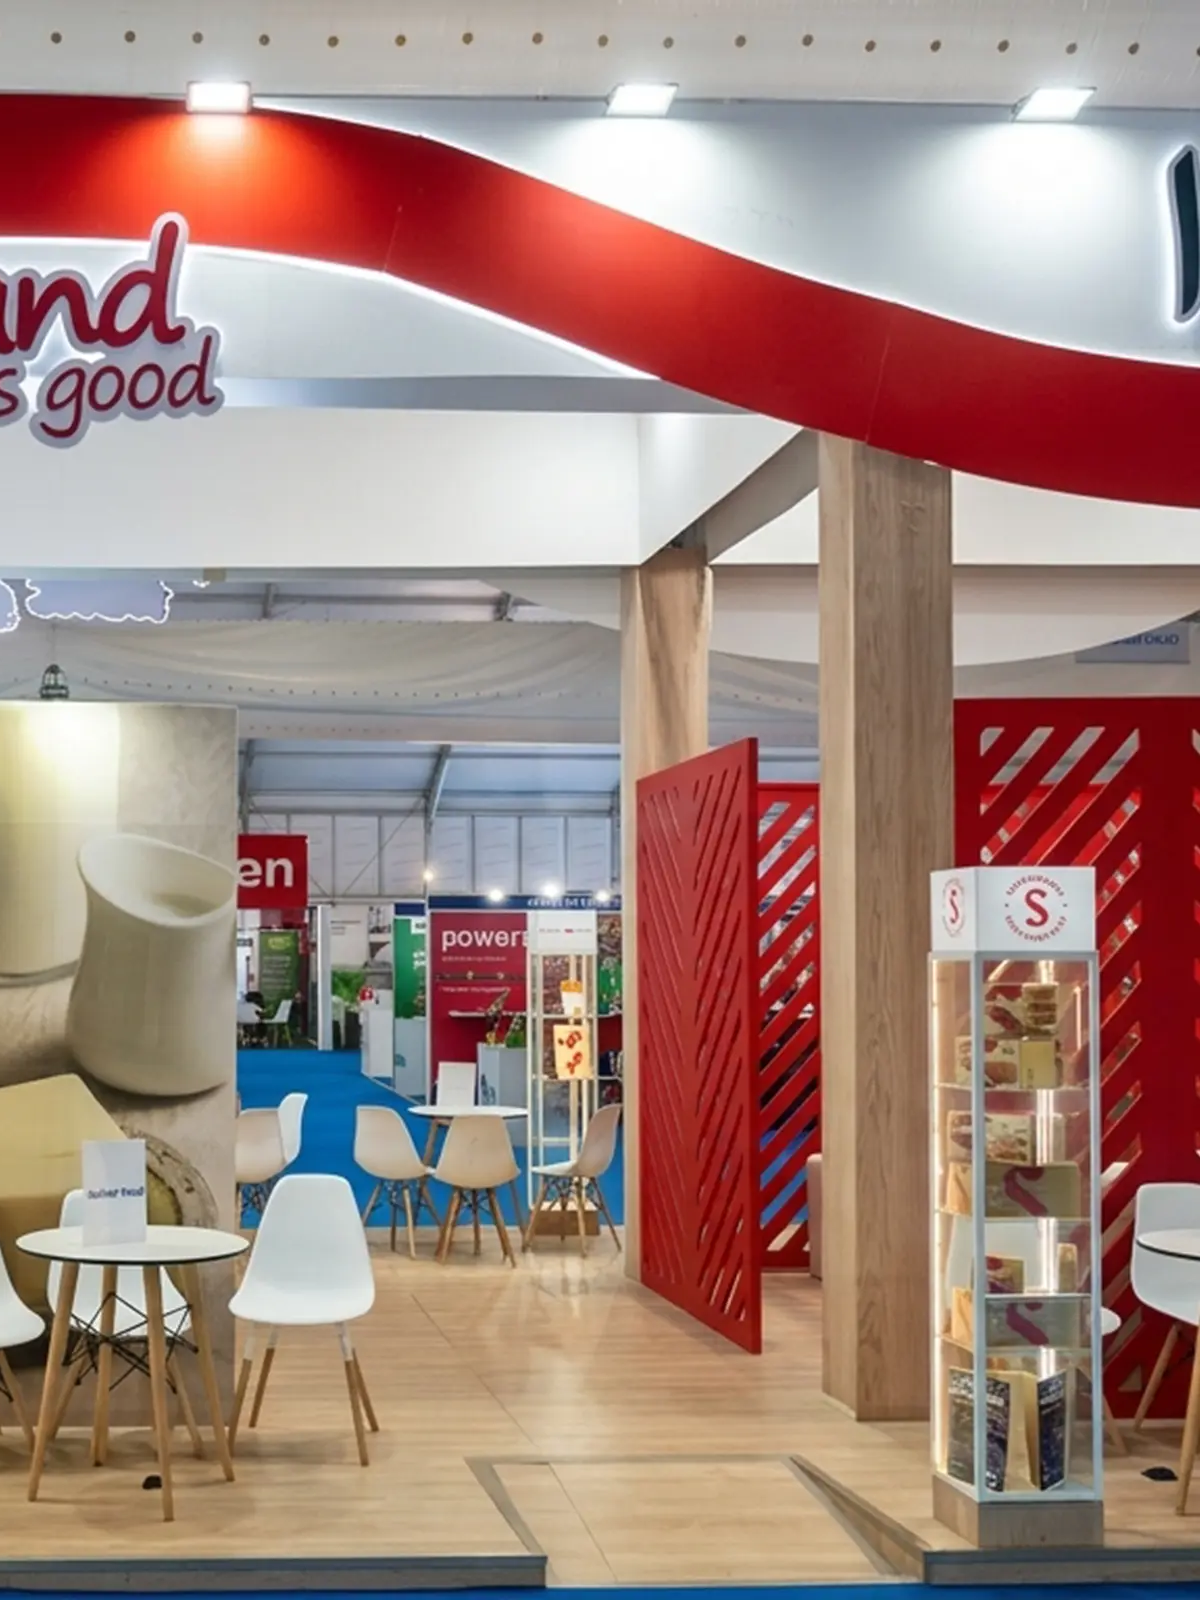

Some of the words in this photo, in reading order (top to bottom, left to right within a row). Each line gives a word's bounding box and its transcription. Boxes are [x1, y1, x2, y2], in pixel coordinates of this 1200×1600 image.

[39, 335, 217, 439] good
[237, 857, 294, 888] en
[1025, 888, 1049, 927] S
